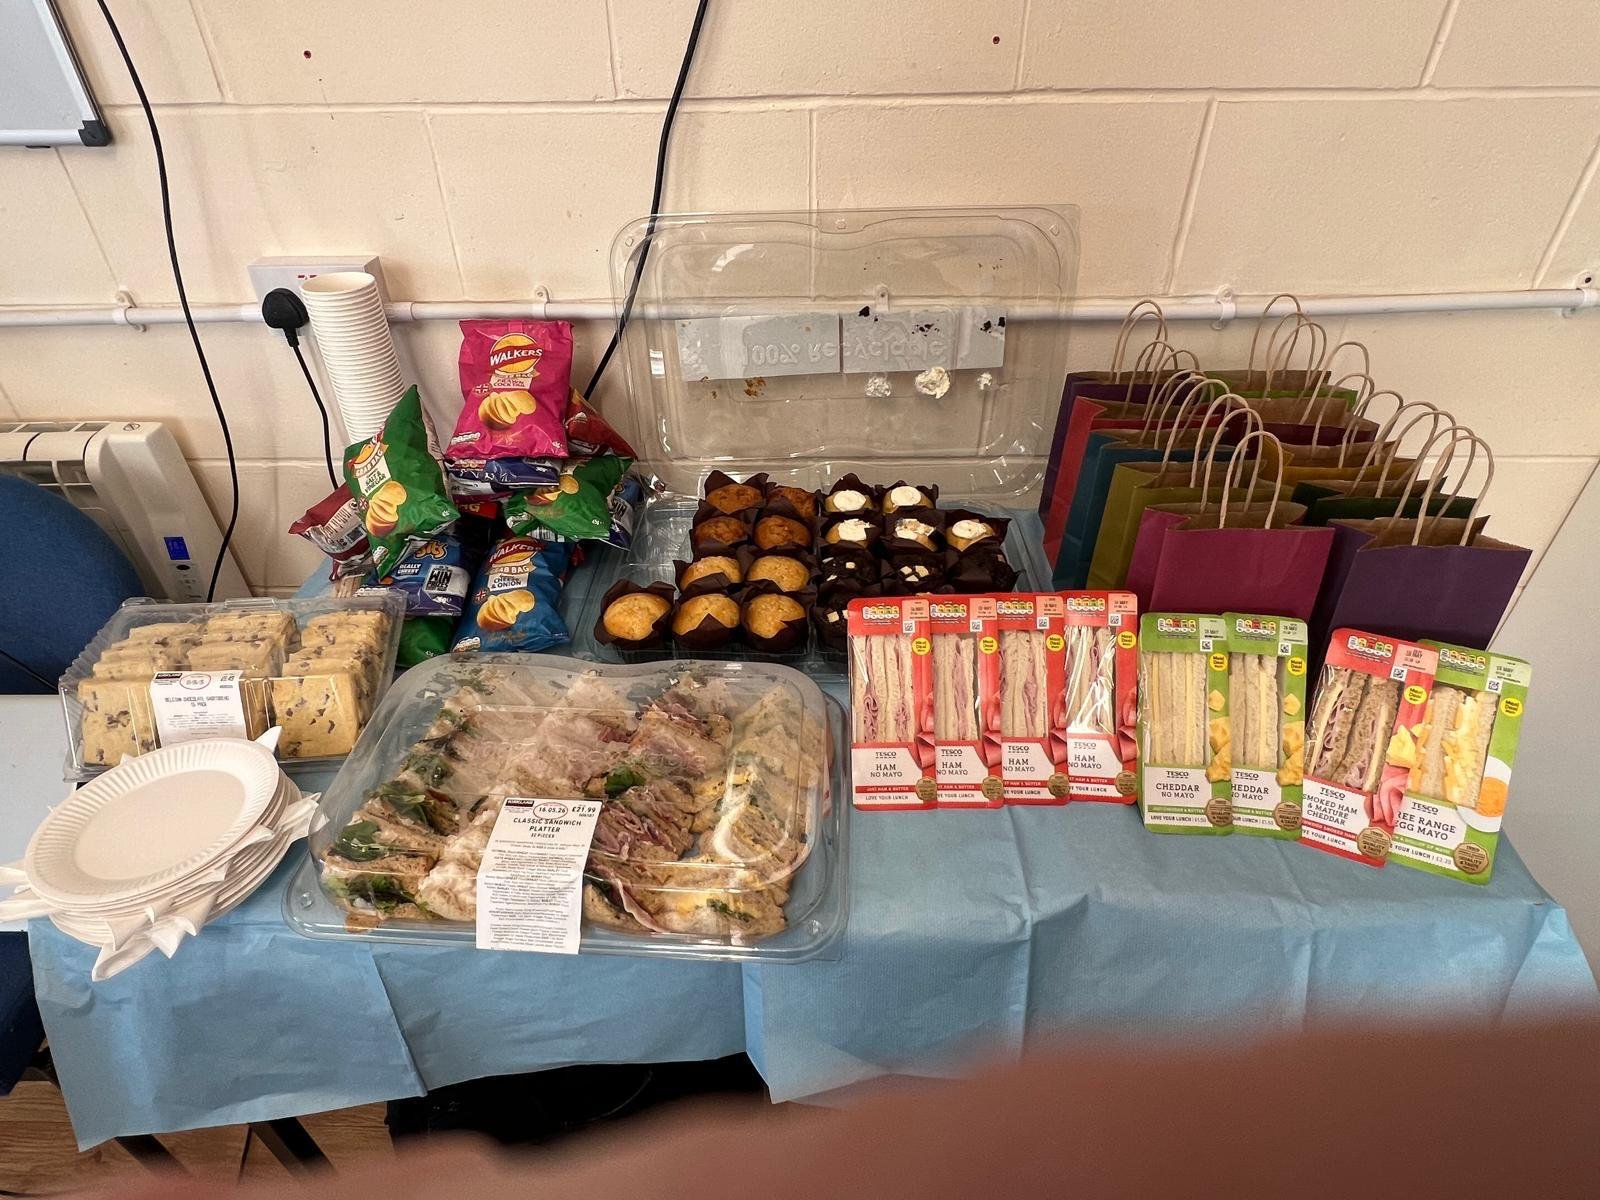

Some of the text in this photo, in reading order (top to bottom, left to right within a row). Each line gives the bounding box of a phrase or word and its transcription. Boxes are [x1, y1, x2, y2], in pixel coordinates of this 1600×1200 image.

[490, 349, 543, 366] WALKERS
[511, 565, 529, 573] BAG
[430, 570, 452, 583] WIN
[1155, 783, 1200, 792] CHEDDAR
[1231, 784, 1269, 794] HEDDAR
[1320, 787, 1346, 799] TESCO
[1303, 794, 1358, 814] SMOKED HAM
[1412, 802, 1439, 813] TESCO
[1306, 809, 1346, 826] CHEDDAR
[1315, 804, 1349, 820] MATURE
[1398, 811, 1456, 834] REE RANGE
[1311, 832, 1326, 840] YOUR
[1327, 836, 1346, 846] LUNCH
[1417, 827, 1448, 841] MAYO
[1394, 845, 1431, 859] YOUR LUNCH
